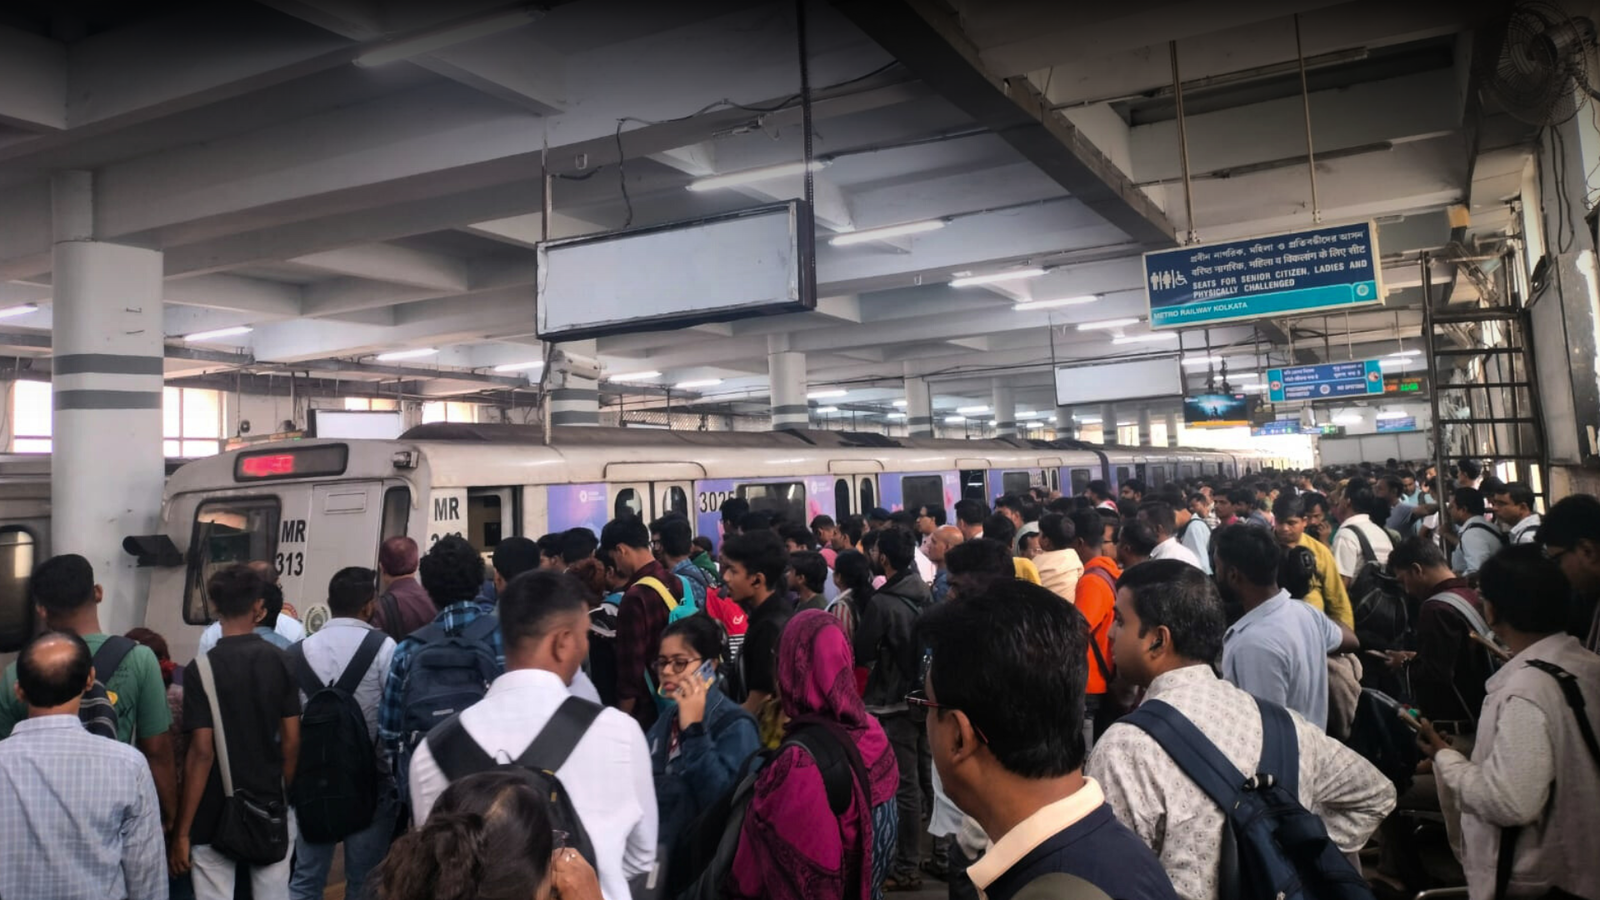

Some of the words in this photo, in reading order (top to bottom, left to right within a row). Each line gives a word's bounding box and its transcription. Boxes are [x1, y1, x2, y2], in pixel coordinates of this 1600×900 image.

[1192, 279, 1217, 290] SEATS
[1220, 277, 1237, 286] FOR
[1240, 272, 1271, 284] SENIOR
[1275, 267, 1310, 279] CITIZEN,
[1314, 262, 1345, 274] LADIES
[1349, 259, 1368, 269] AND
[1193, 286, 1239, 299] PHYSICALLY
[1243, 278, 1295, 292] CHALLENGED
[1153, 310, 1179, 319] METRO
[1180, 305, 1213, 316] RAILWAY
[1213, 302, 1248, 312] KOLKATA
[434, 496, 460, 521] MR
[281, 519, 306, 543] MR
[275, 551, 304, 576] 313
